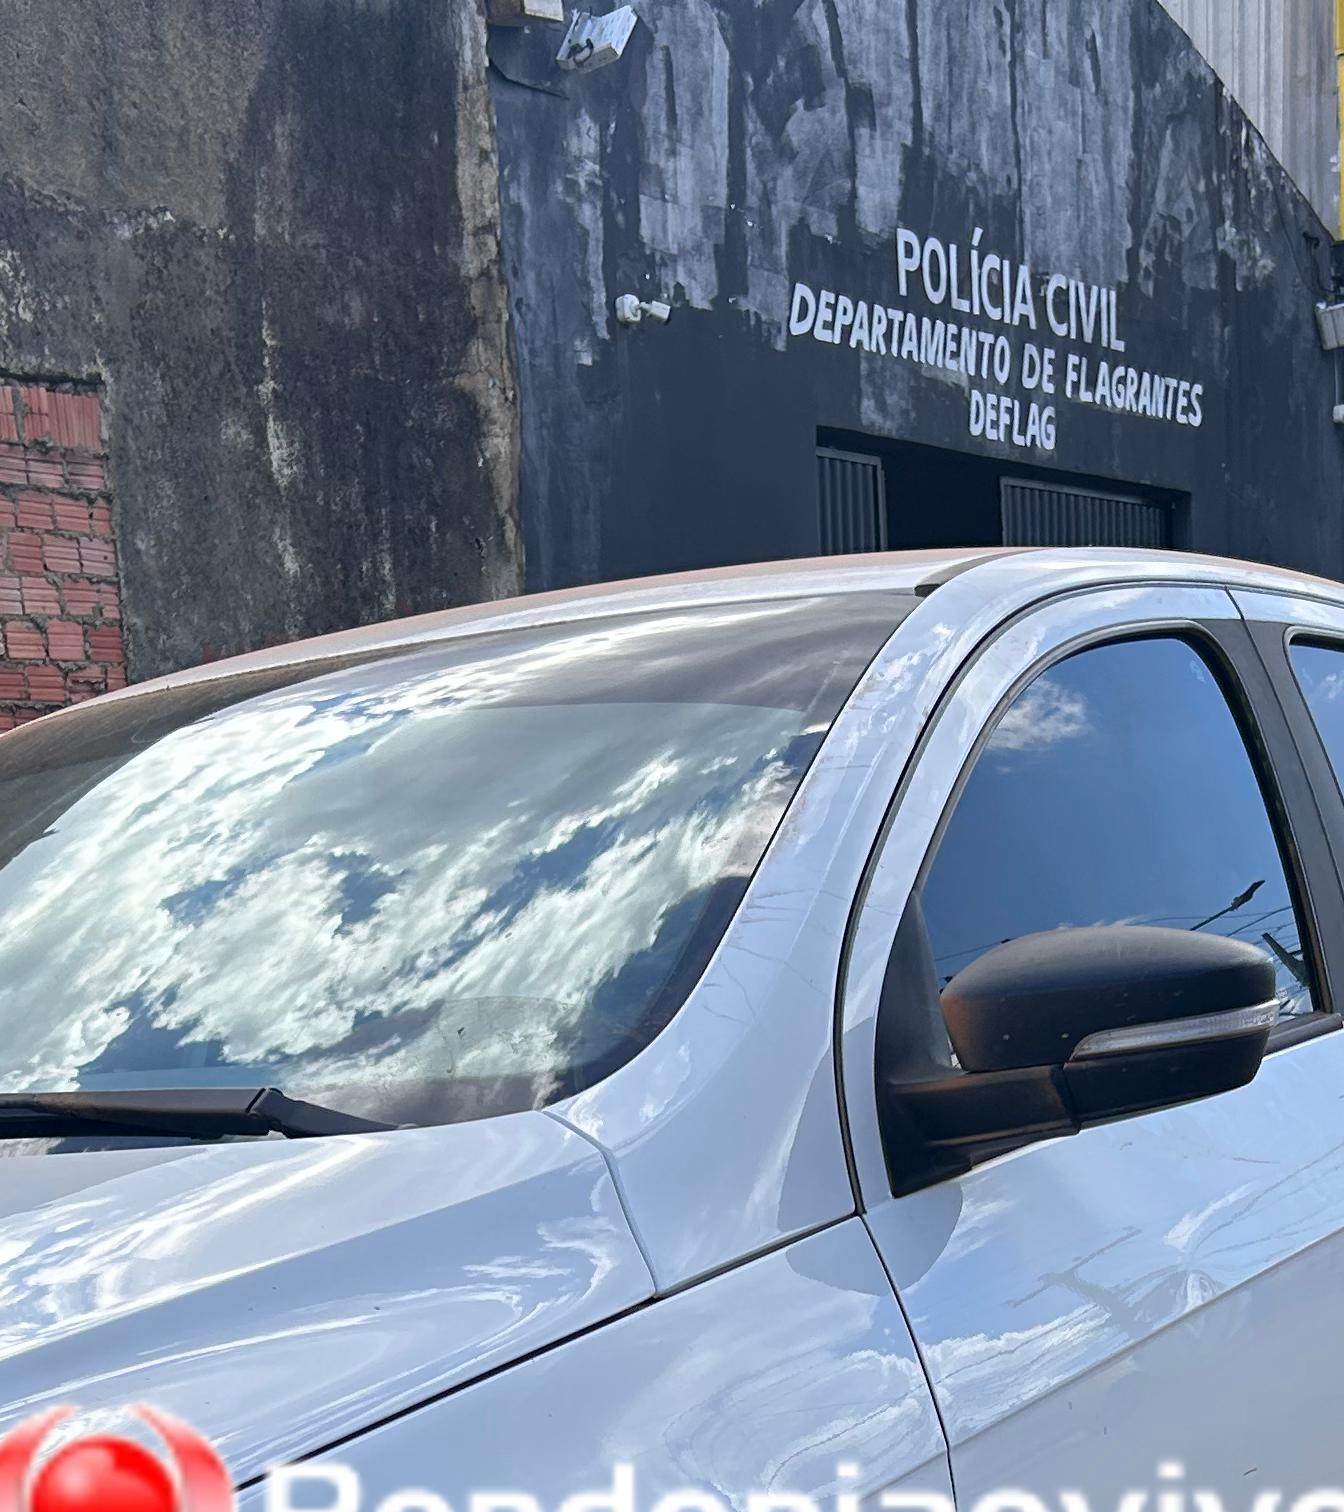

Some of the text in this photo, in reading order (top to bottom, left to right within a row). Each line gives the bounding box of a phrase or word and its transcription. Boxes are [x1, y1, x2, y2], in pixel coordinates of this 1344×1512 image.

[895, 226, 1126, 352] POLÍCIA CIVIL
[788, 282, 1203, 428] DEPARTAMENTO DE FLAGRANTES
[968, 389, 1056, 451] DEFLAG
